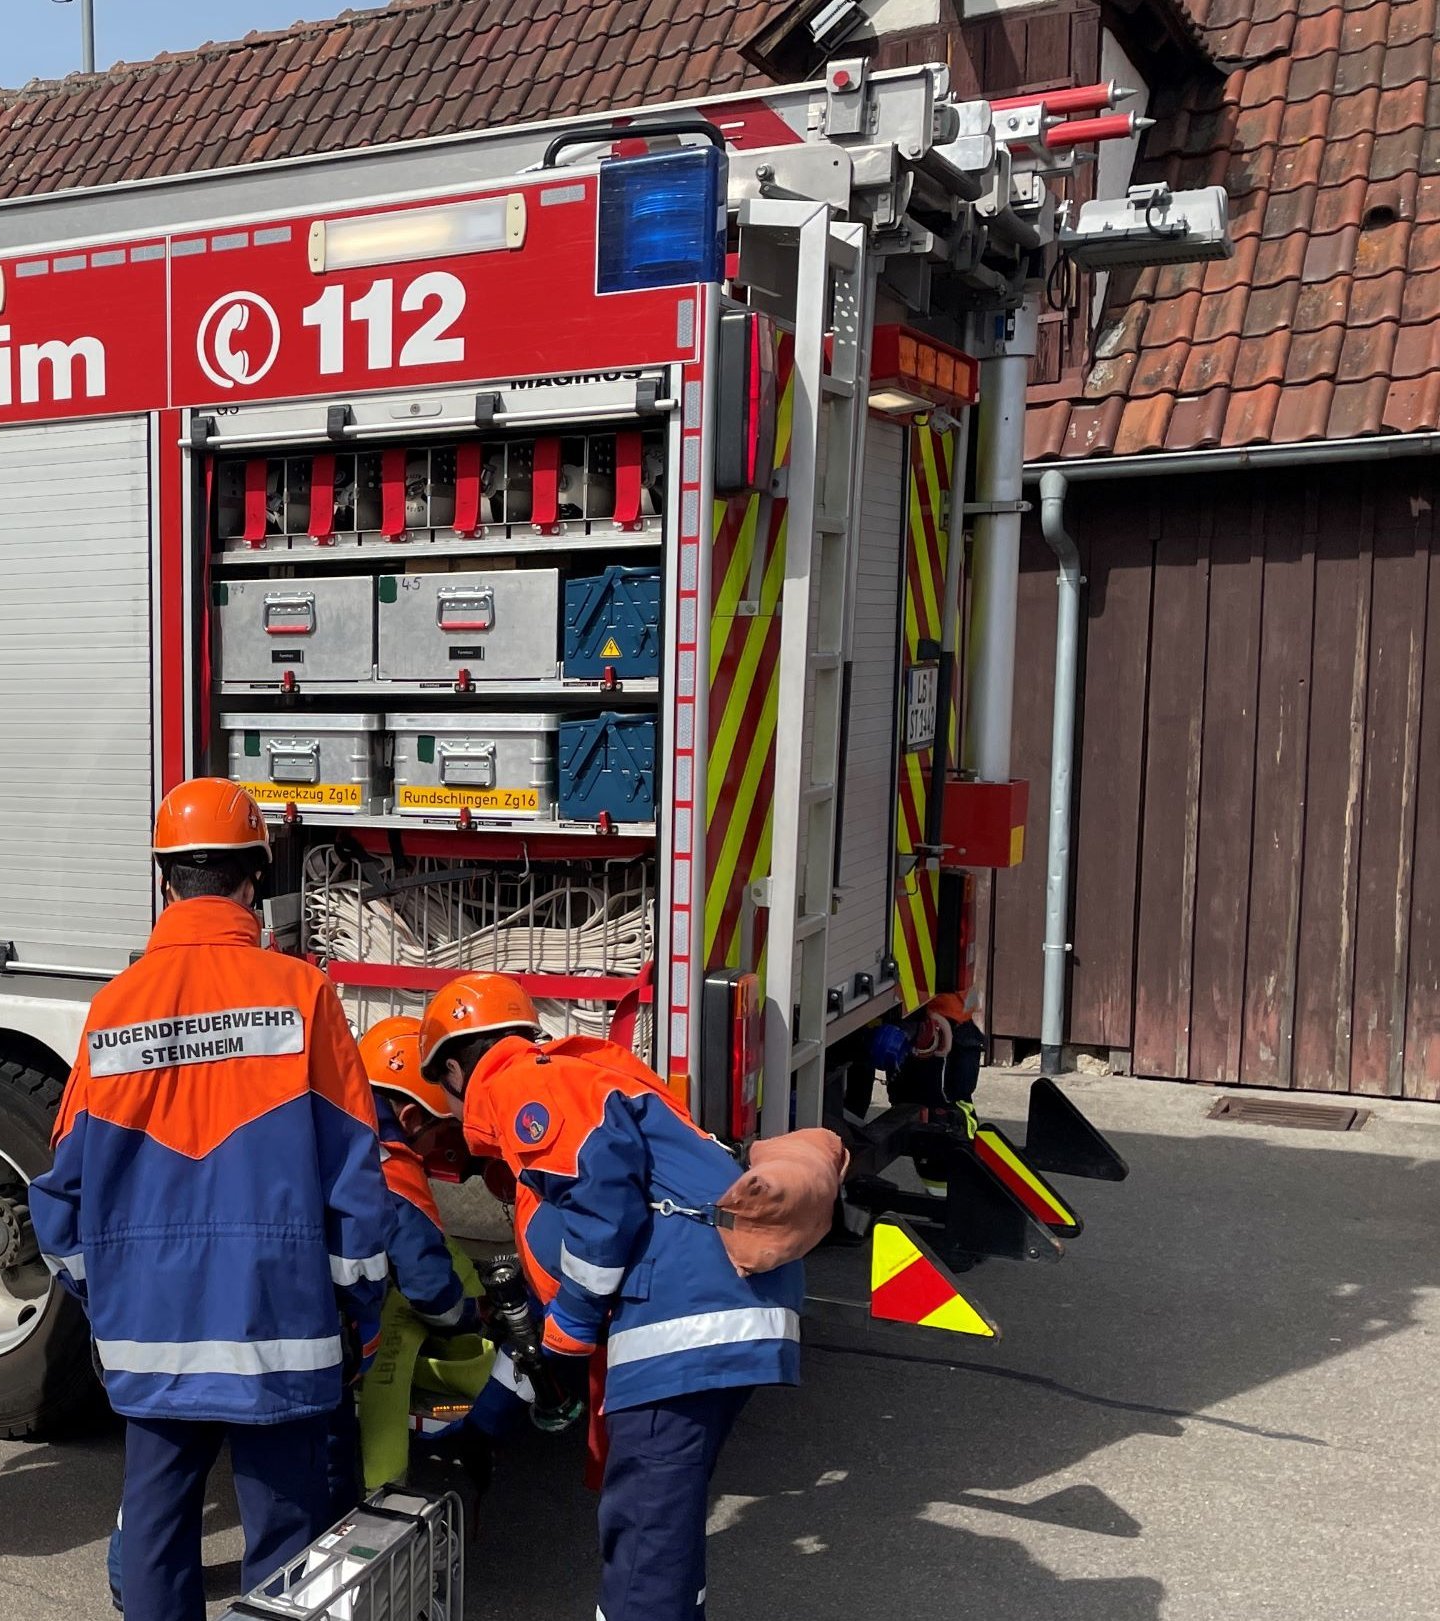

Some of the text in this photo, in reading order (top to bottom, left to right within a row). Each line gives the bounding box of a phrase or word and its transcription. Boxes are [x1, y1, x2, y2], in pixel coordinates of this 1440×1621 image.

[303, 271, 466, 375] 112
[401, 577, 422, 590] 45
[329, 788, 357, 801] Zg16
[404, 791, 536, 807] Rundschlingen Zg16
[92, 1010, 295, 1049] JUGENDFEUERWEHR
[141, 1036, 244, 1064] STEINHEIM
